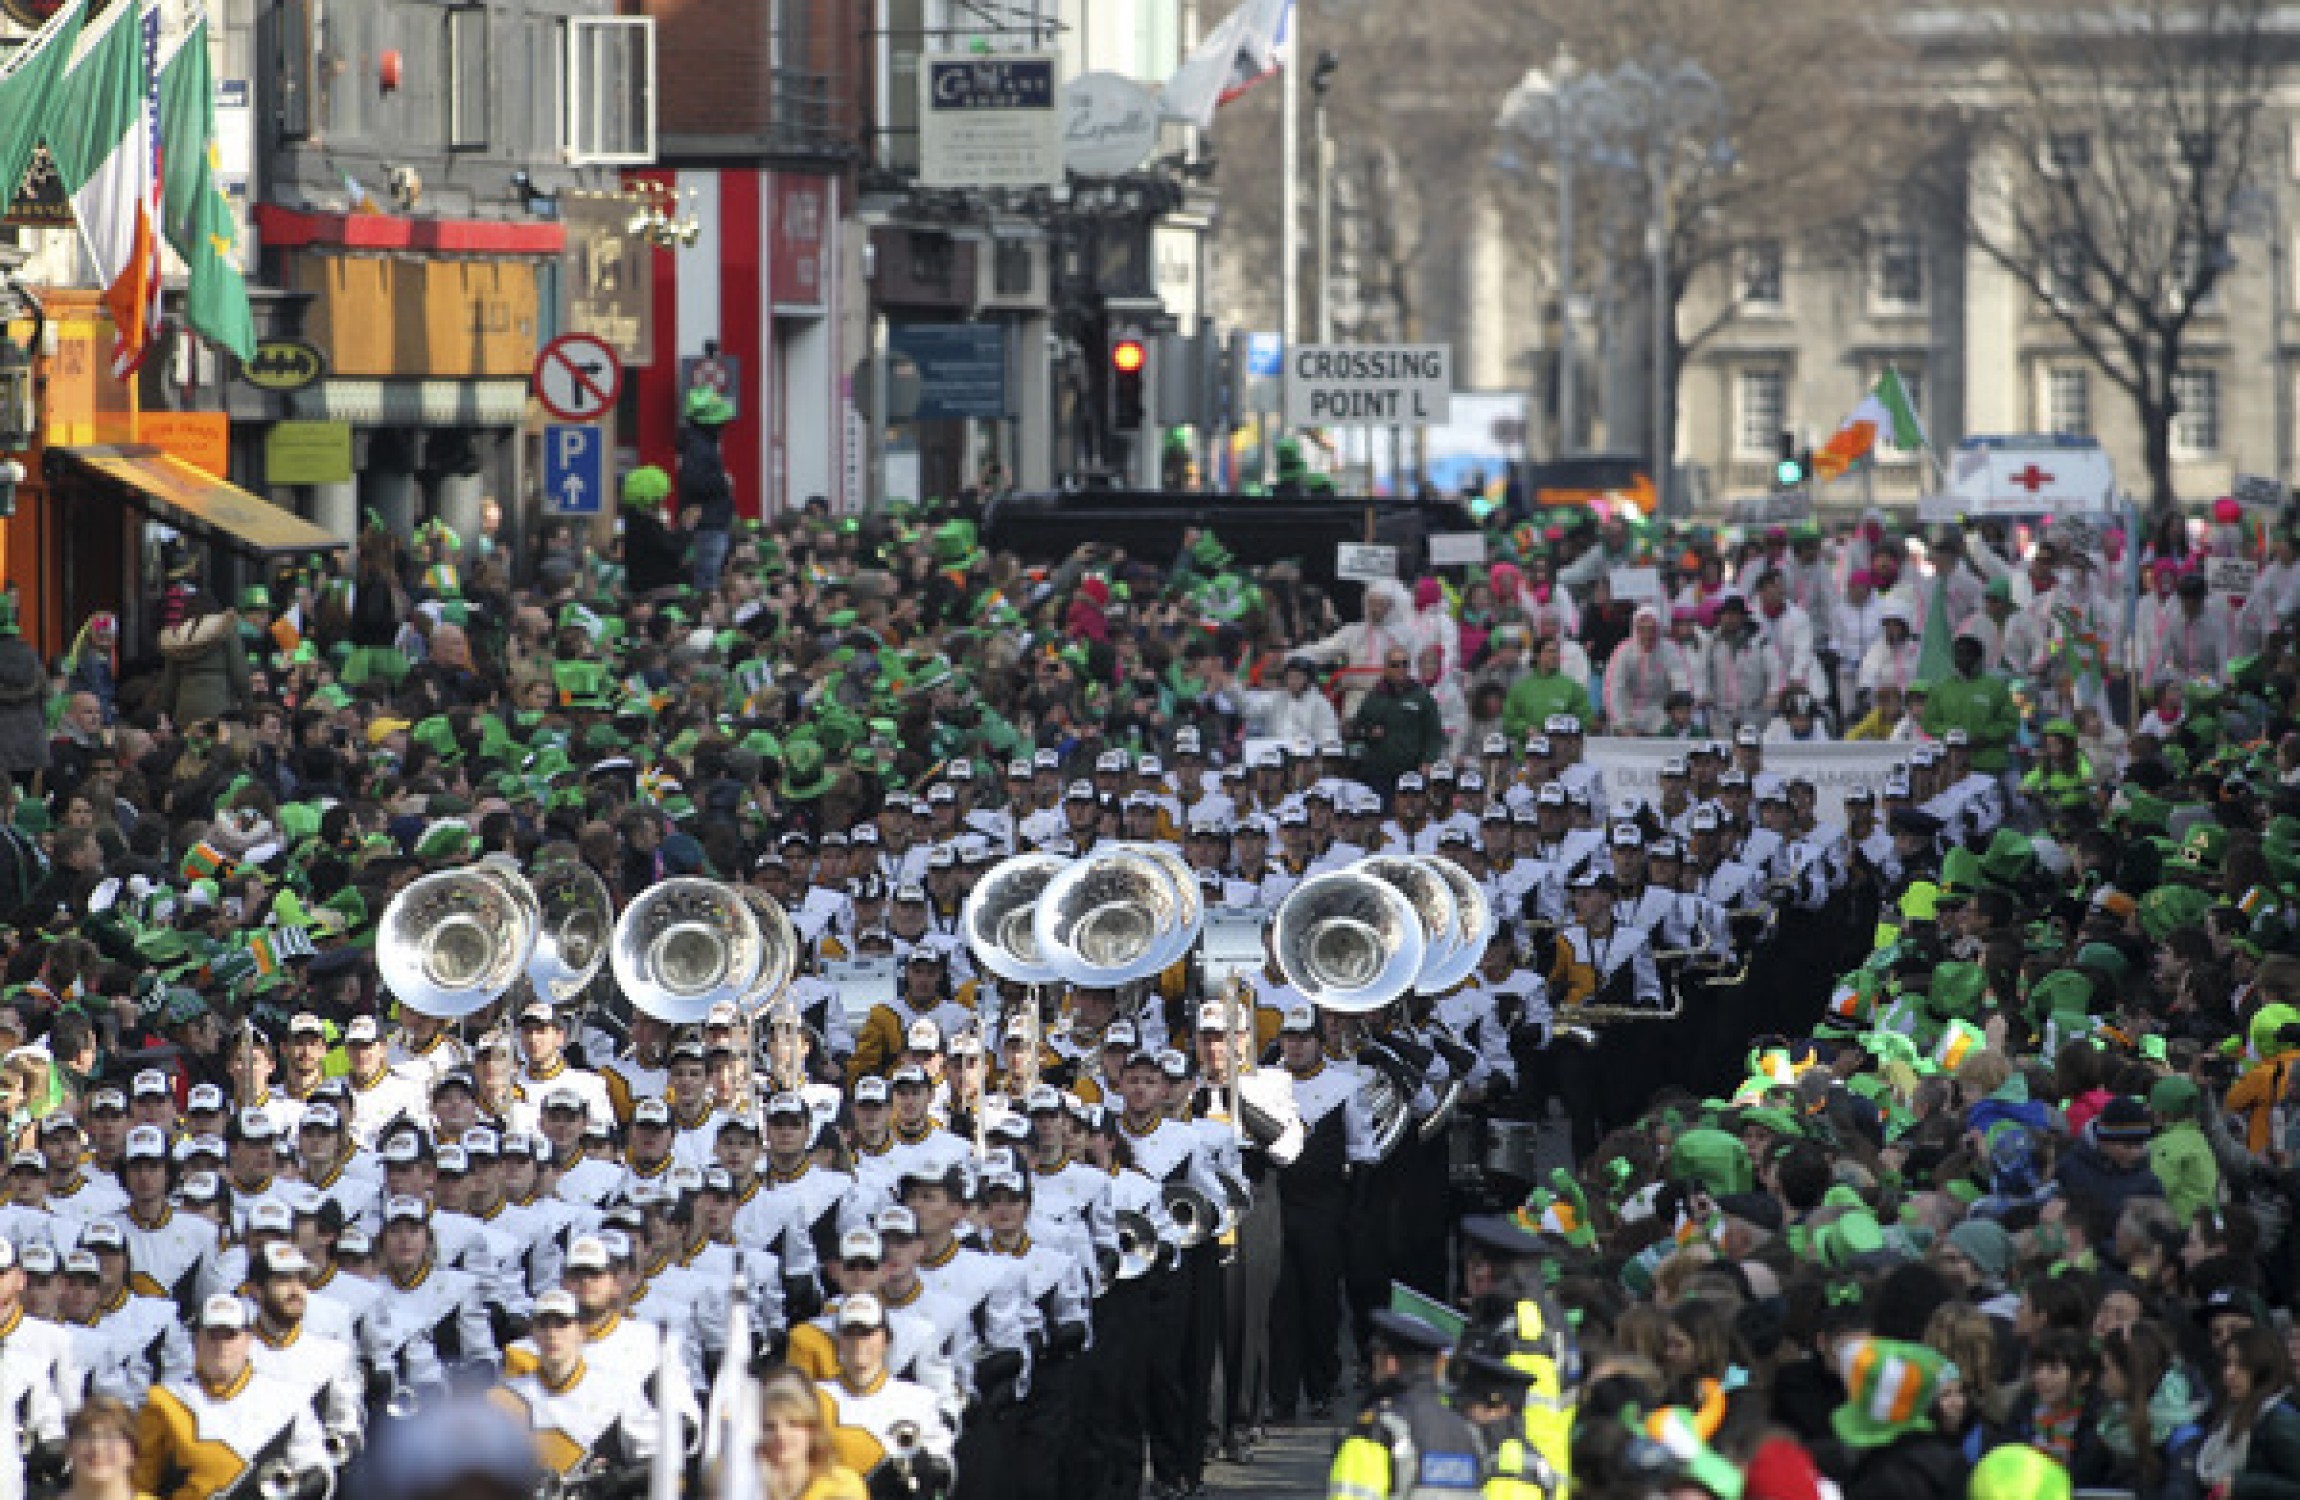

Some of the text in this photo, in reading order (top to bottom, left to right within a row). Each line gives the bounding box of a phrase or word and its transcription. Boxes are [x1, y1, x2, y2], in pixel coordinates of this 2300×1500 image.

[1296, 350, 1441, 380] CROSSING
[1311, 388, 1430, 418] POINT L
[560, 430, 586, 469] P
